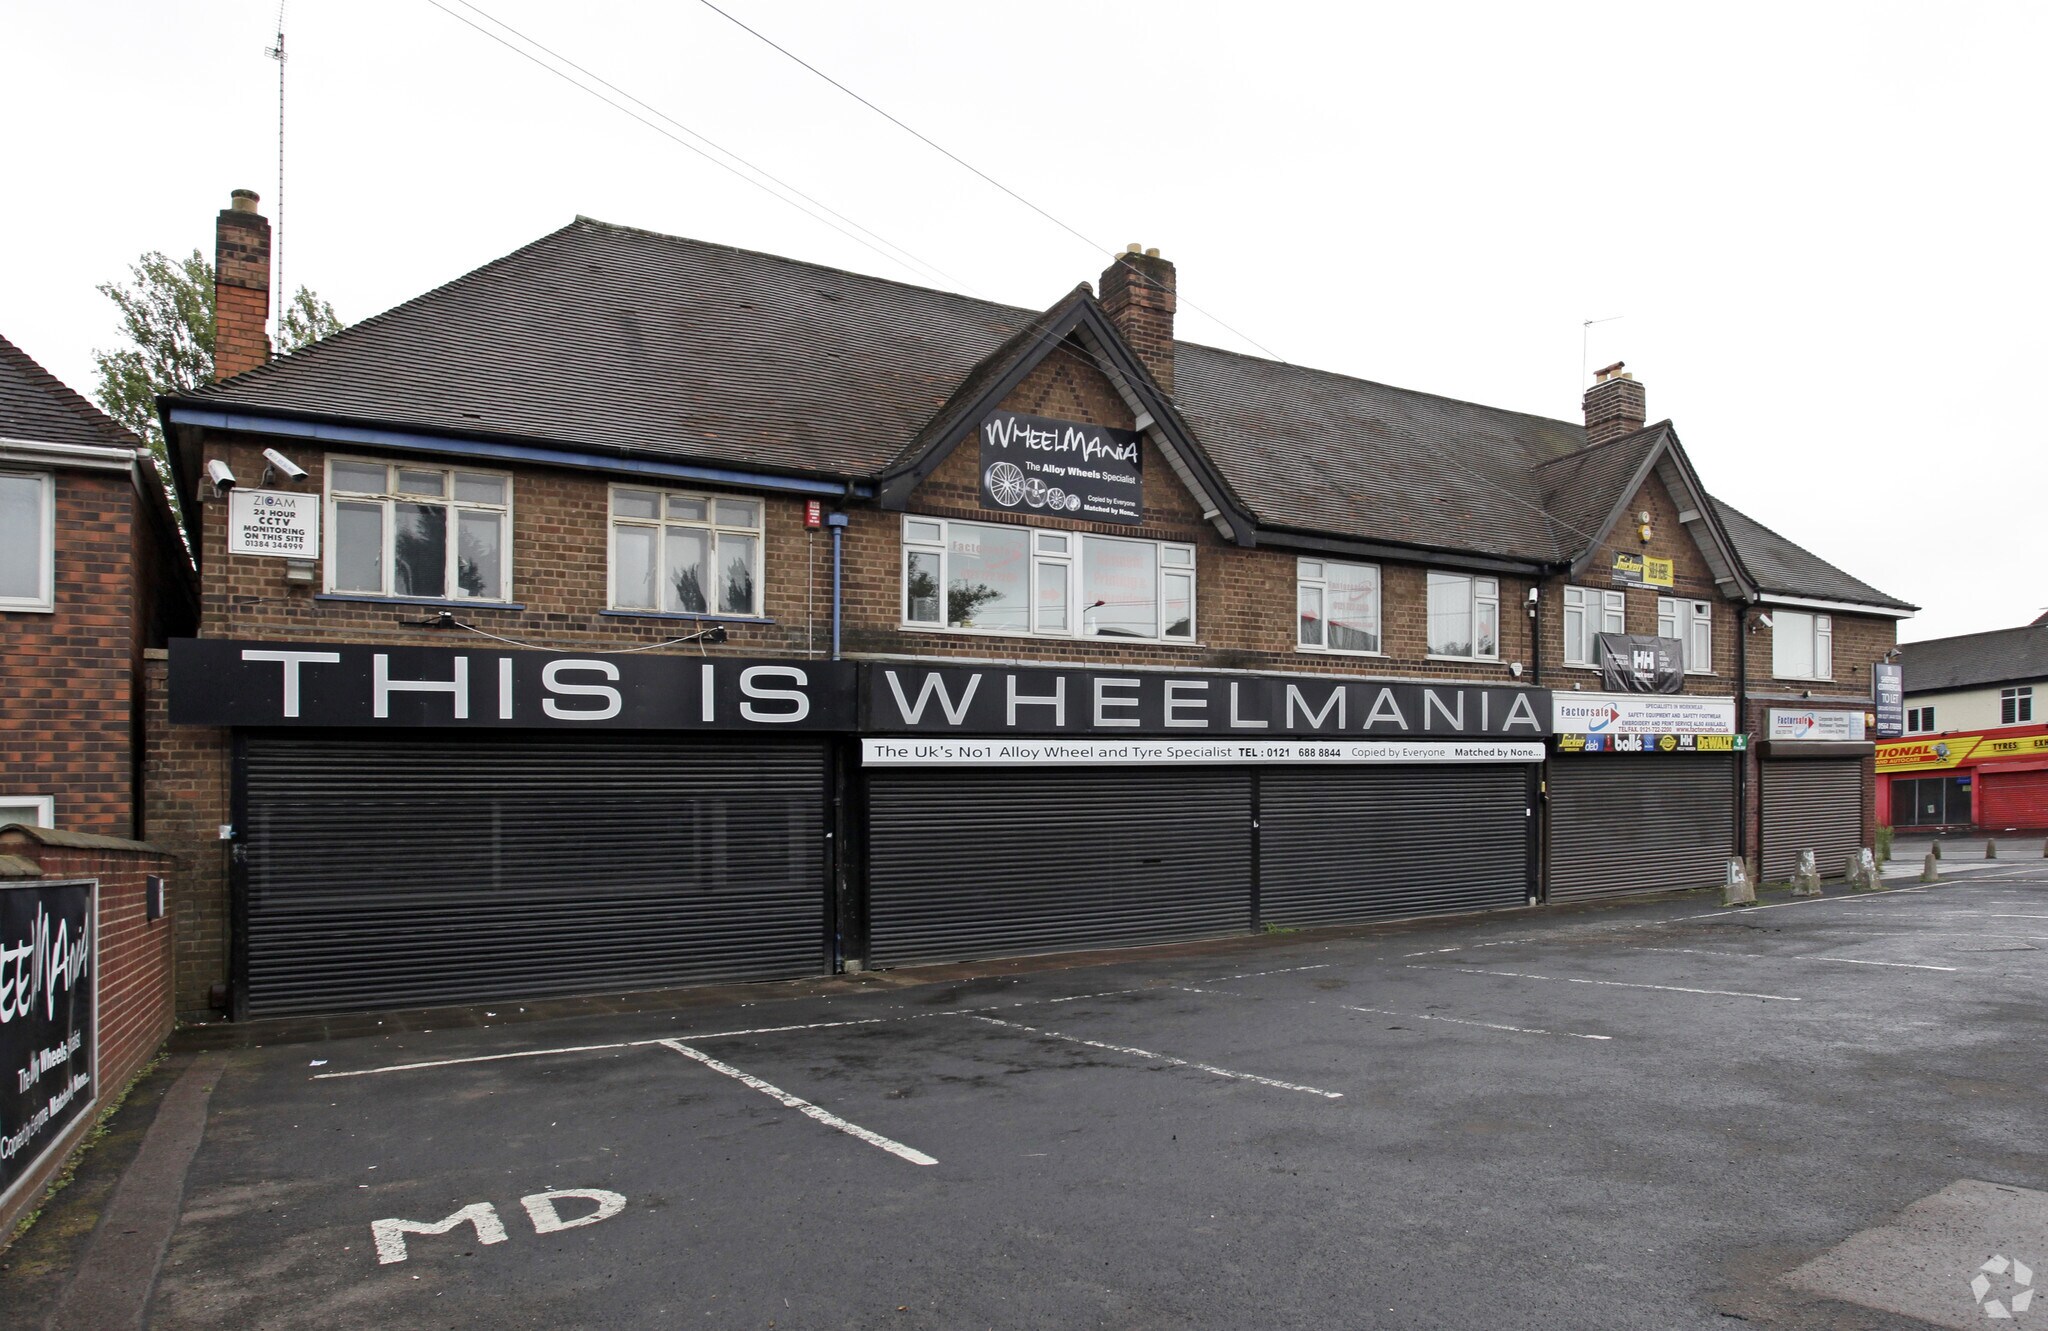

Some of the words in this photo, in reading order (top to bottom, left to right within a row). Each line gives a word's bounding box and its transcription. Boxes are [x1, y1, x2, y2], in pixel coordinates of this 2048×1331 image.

[1025, 460, 1041, 471] The
[1042, 464, 1066, 476] Alloy
[1067, 466, 1100, 479] Wheels
[1102, 471, 1136, 485] Specialist
[1088, 494, 1106, 503] Copied
[1106, 497, 1112, 505] by
[1113, 498, 1136, 507] Everyone
[269, 510, 296, 518] HOUR
[1083, 504, 1110, 513] Matched
[1111, 507, 1118, 515] by
[258, 517, 290, 526] CCTV
[243, 525, 305, 535] MONITORING
[262, 533, 283, 541] THIS
[272, 541, 303, 550] 344999
[241, 649, 622, 722] THIS
[701, 663, 810, 724] IS
[885, 670, 1541, 732] WHEELMANIA
[1881, 693, 1890, 704] TO
[1890, 694, 1899, 704] LET
[1561, 706, 1609, 717] Factorsafe
[1777, 715, 1807, 724] Factorsafe
[1584, 739, 1599, 751] deb
[1614, 733, 1643, 751] bollé
[1680, 734, 1693, 746] HH
[1993, 742, 2017, 751] TYRES
[874, 745, 908, 758] The
[915, 745, 953, 758] Uk's
[959, 746, 992, 758] No1
[1000, 746, 1039, 760] Alloy
[1044, 746, 1094, 758] Wheel
[1098, 746, 1128, 758] and
[1132, 747, 1163, 760] Tyre
[1167, 746, 1232, 761] Specialist
[1267, 748, 1290, 757] 0121
[1298, 748, 1316, 757] 688
[1318, 748, 1341, 757] 8844
[1351, 748, 1385, 760] Copied
[1388, 748, 1400, 760] by
[1402, 748, 1445, 760] Everyone
[1455, 748, 1493, 757] Matched
[1496, 748, 1507, 760] by
[40, 1040, 68, 1073] Wheels
